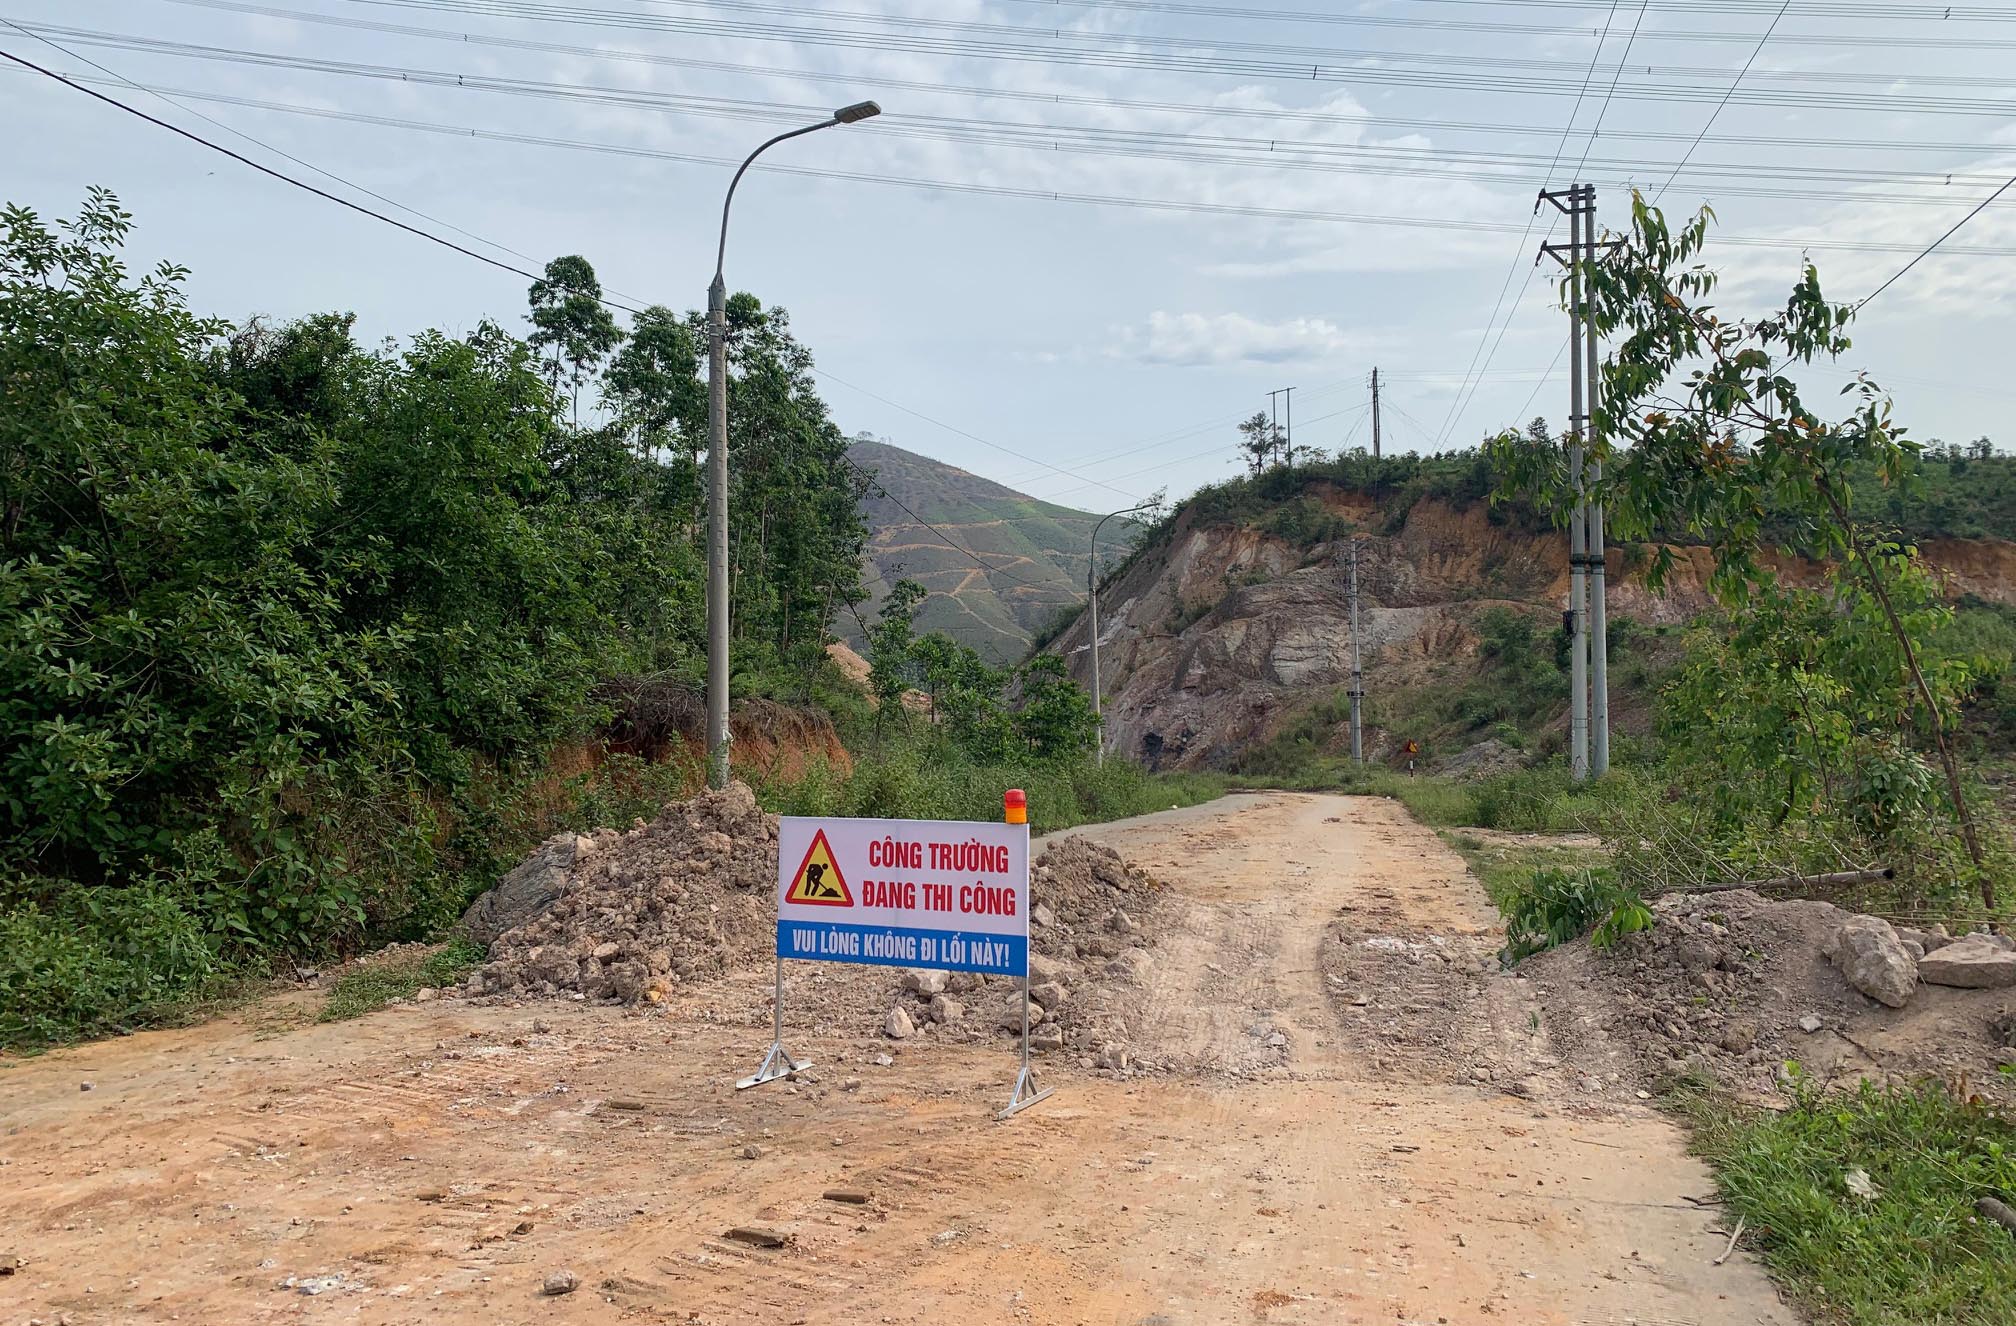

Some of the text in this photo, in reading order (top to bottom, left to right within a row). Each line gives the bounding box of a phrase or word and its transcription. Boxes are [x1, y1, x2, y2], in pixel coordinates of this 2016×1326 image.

[869, 836, 1008, 873] CÔNG TRƯỜNG
[862, 881, 1016, 916] ĐANG THI CÔNG
[793, 926, 1009, 967] VUI LÒNG KHÔNG ĐI LỐI NÀY!
